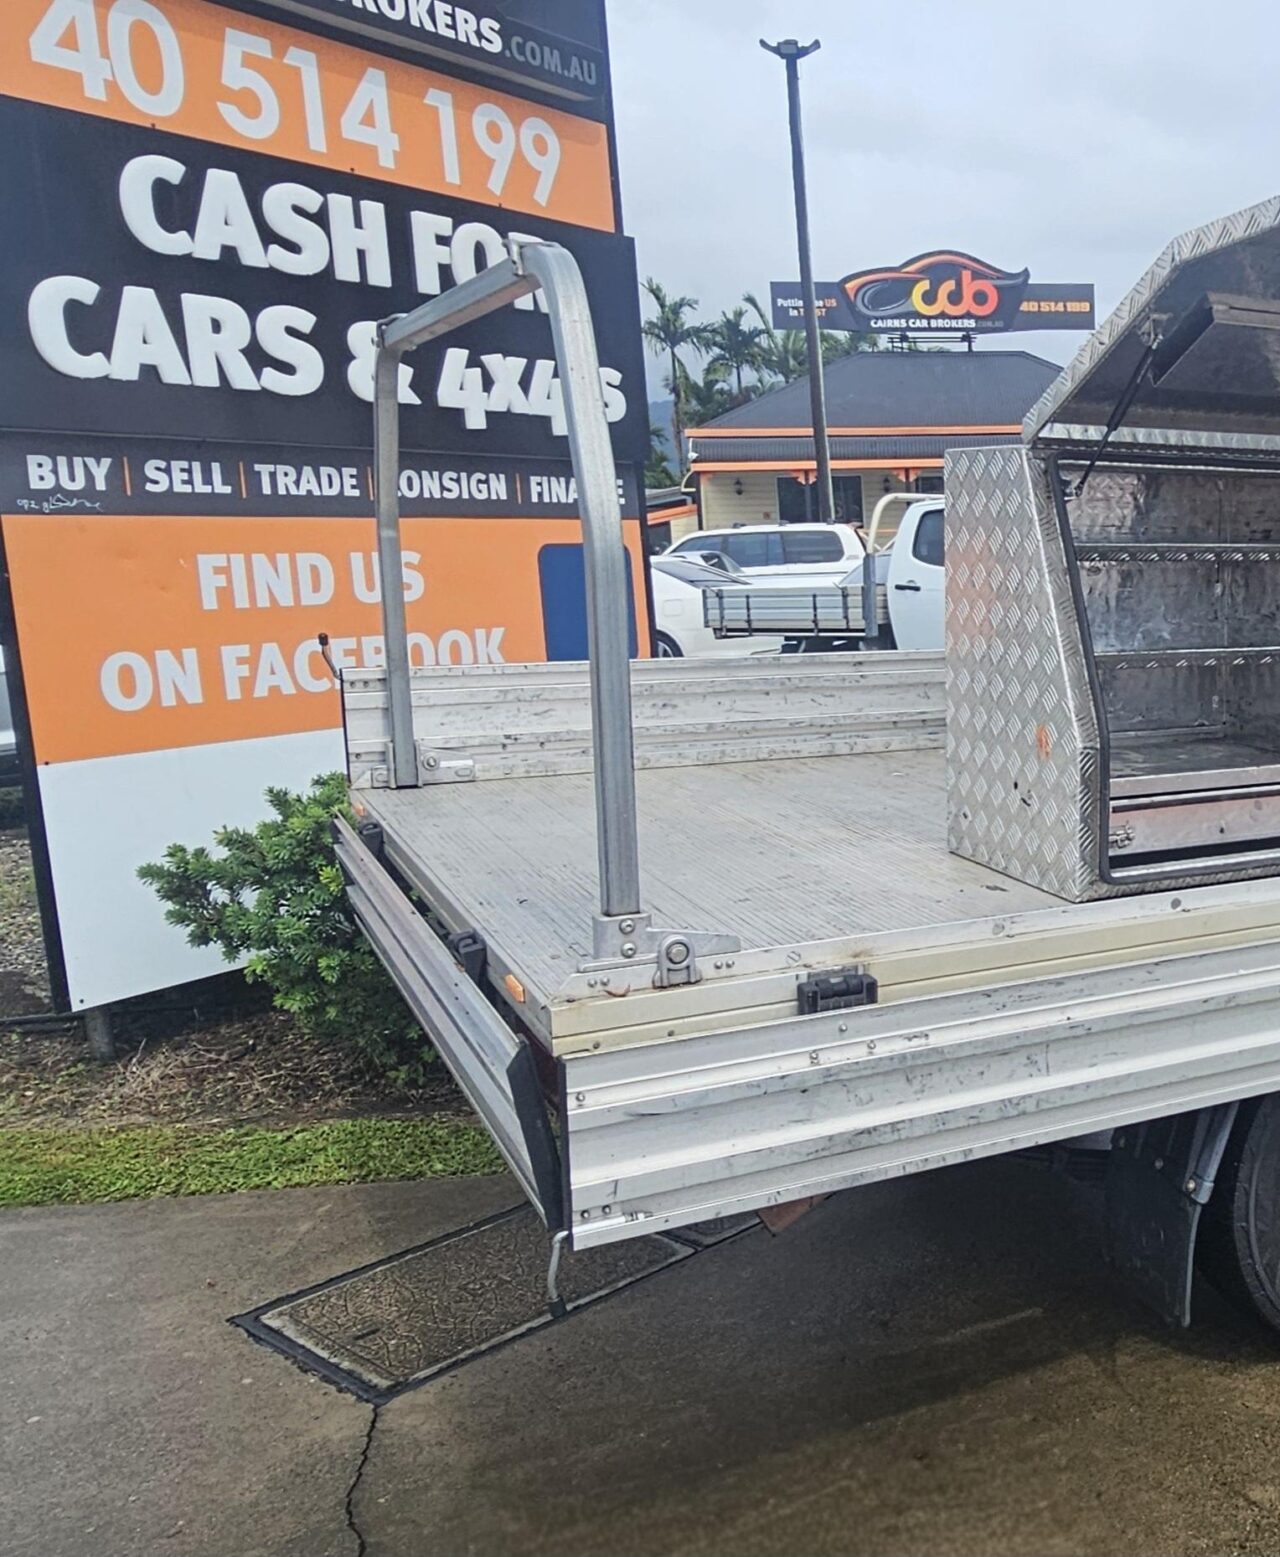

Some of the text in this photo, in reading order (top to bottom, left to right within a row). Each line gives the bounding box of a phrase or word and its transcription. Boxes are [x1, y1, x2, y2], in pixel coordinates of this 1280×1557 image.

[29, 0, 561, 207] 40 514 199
[119, 154, 549, 314] CASH FO
[28, 275, 325, 397] CARS
[347, 313, 422, 405] &
[870, 319, 907, 328] CAIRNS
[908, 319, 929, 328] CAR
[26, 455, 626, 504] BUY SELL TRADE ONSIGN FINAE
[197, 552, 425, 610] FIND US
[101, 648, 203, 711] ON
